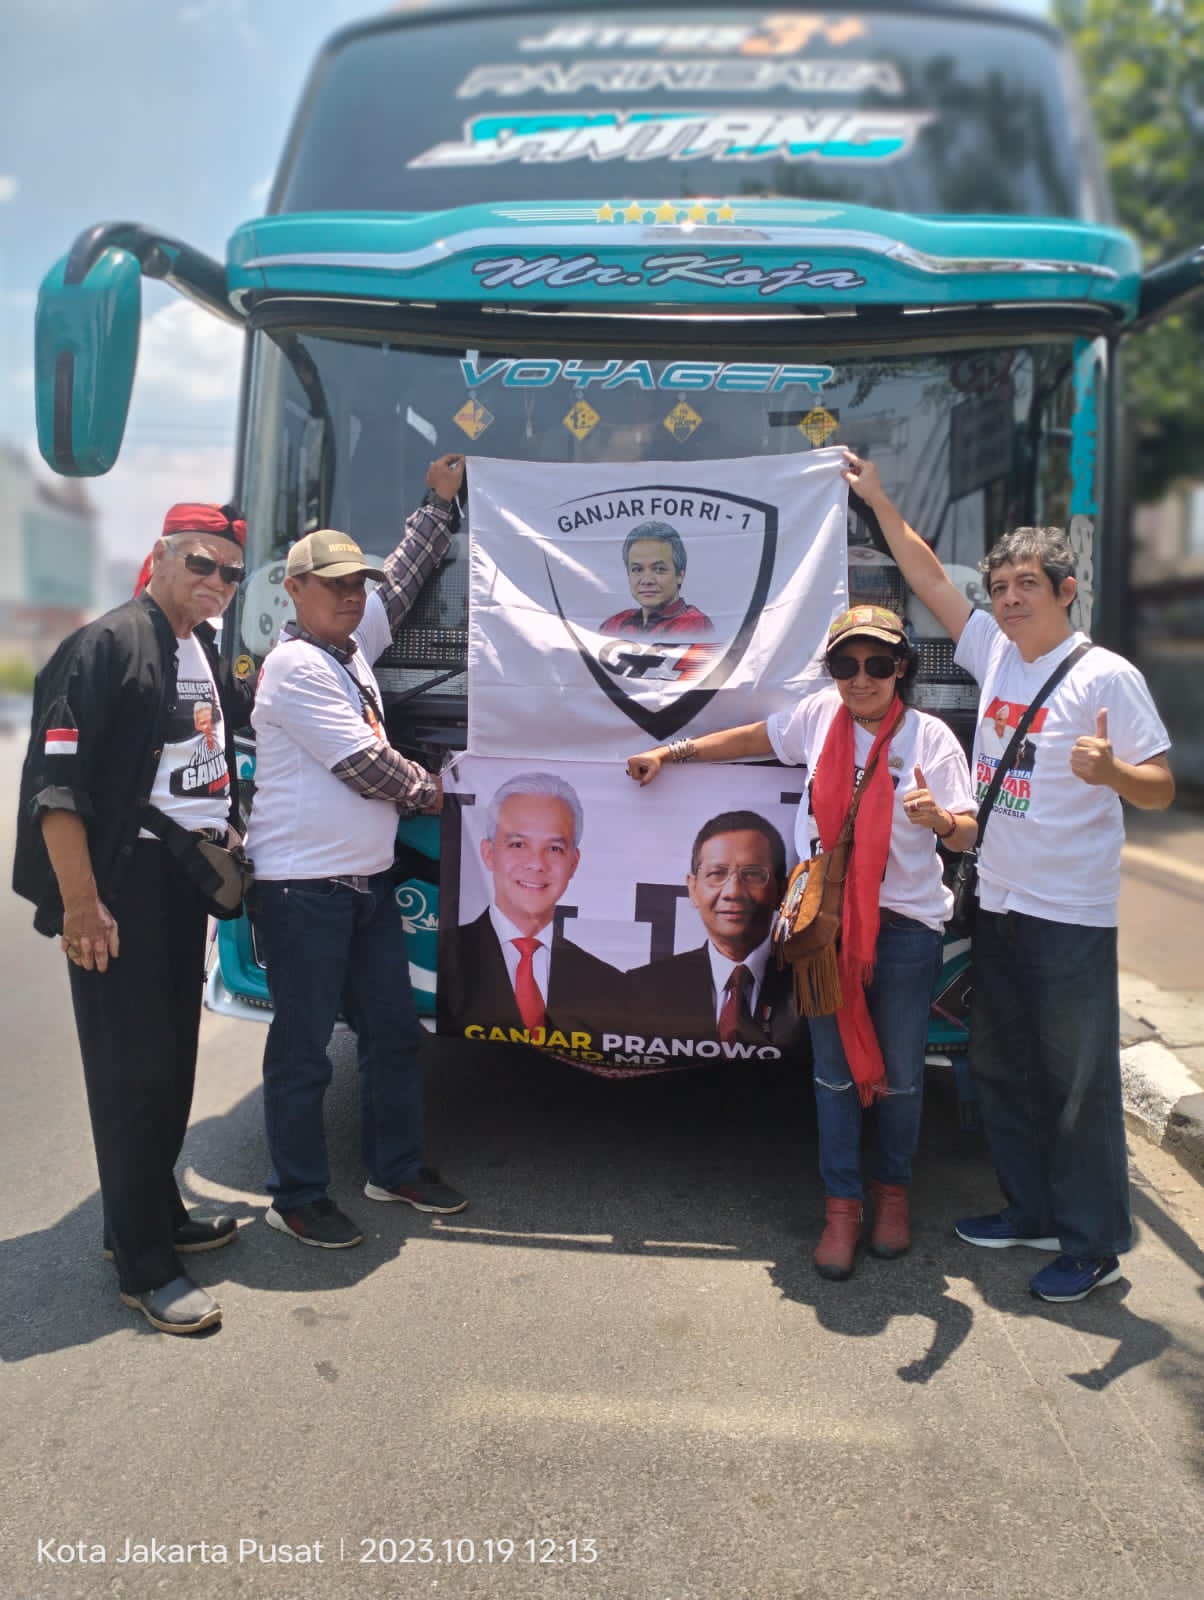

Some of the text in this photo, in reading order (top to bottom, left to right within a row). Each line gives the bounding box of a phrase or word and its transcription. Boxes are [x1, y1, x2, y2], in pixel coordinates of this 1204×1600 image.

[459, 358, 835, 394] VOYAGER
[557, 499, 645, 533] GANJAR
[651, 498, 694, 518] FOR
[699, 502, 721, 522] RI
[464, 1024, 593, 1051] GANJAR
[602, 1033, 783, 1060] PRANOWO
